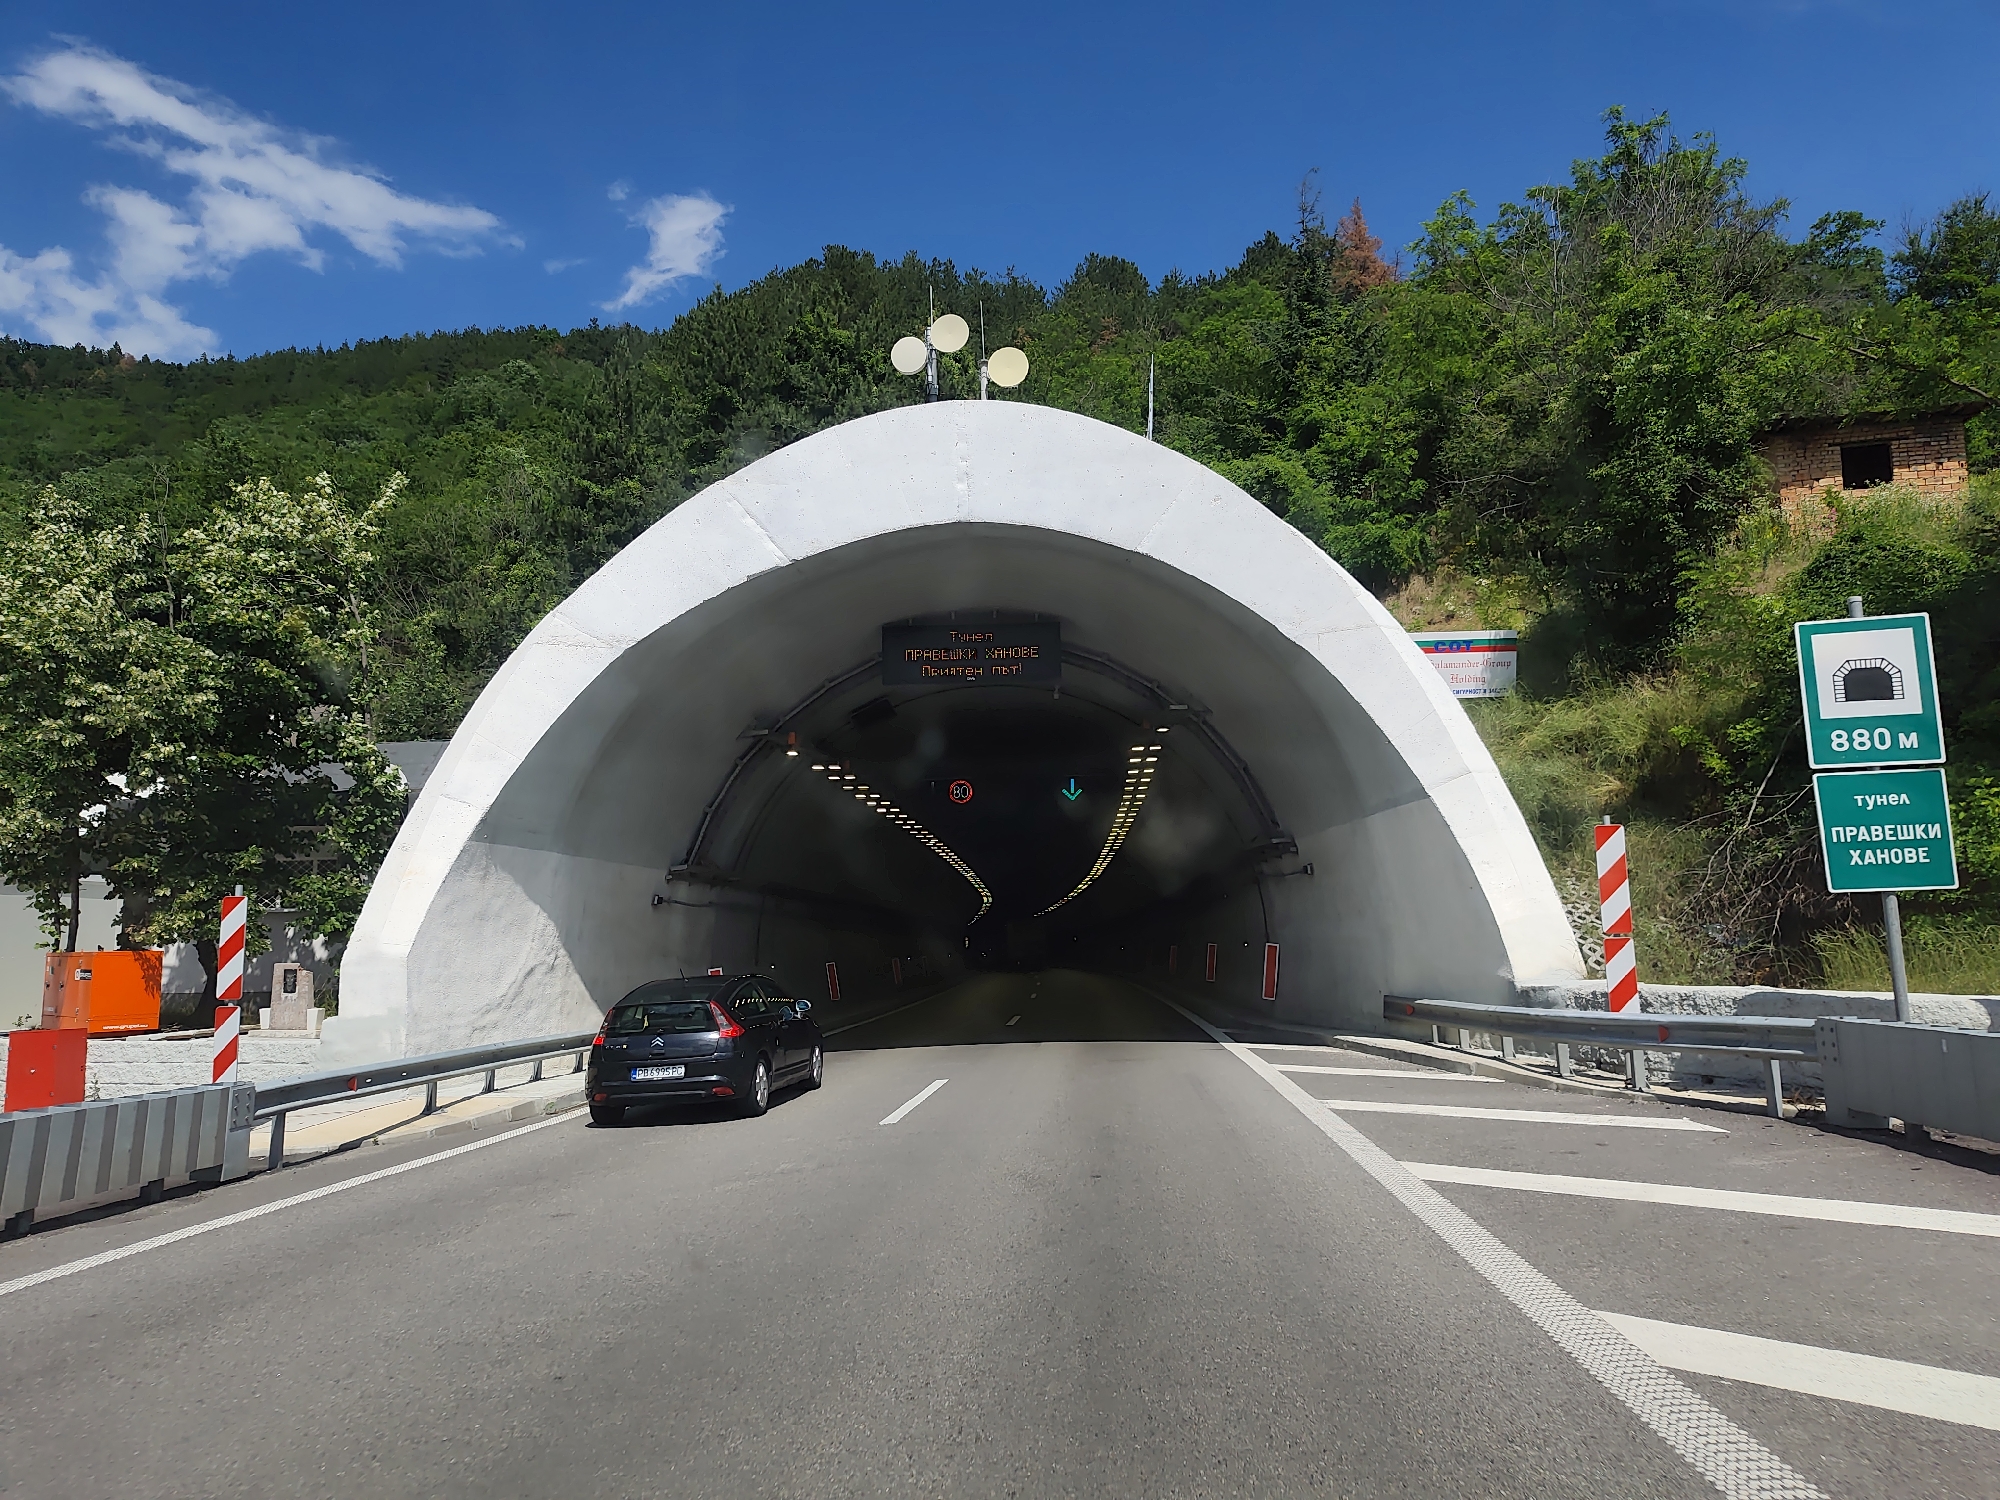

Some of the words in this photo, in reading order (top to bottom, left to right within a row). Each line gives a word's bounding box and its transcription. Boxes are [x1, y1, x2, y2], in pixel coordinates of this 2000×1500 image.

[950, 631, 993, 643] Тунел
[905, 648, 977, 662] ПРАВЕШКИ
[985, 646, 1039, 660] ХАНОВЕ
[922, 665, 983, 677] Приятен
[992, 663, 1022, 676] път!
[1450, 673, 1486, 686] Holding
[1830, 727, 1892, 752] 880
[953, 785, 969, 799] 80
[1853, 793, 1910, 810] тунел
[1831, 823, 1942, 843] ПРАВЕШКИ
[1849, 846, 1931, 866] ХАНОВЕ
